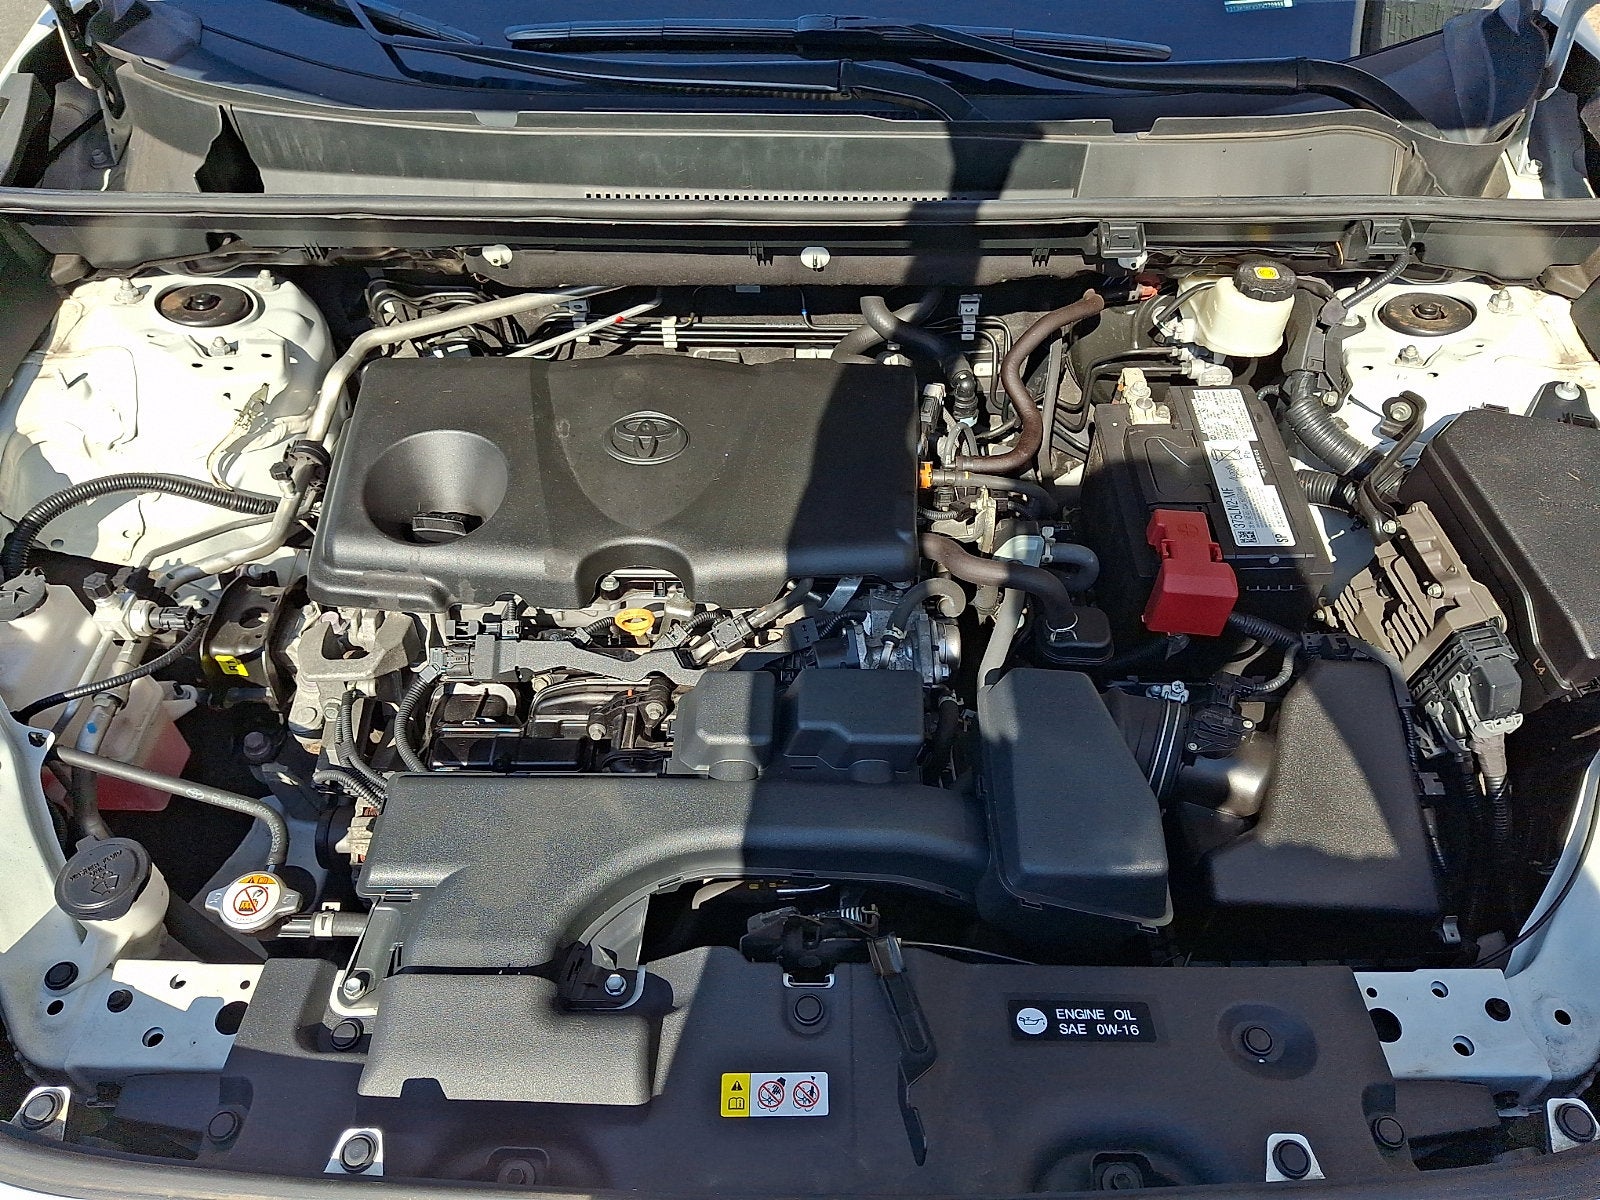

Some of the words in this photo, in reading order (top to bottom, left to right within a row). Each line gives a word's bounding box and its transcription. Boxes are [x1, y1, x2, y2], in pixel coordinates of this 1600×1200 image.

[1221, 487, 1246, 529] 375LN2-MF
[1055, 1008, 1106, 1020] ENGINE
[1113, 1009, 1137, 1021] OIL
[1059, 1023, 1088, 1035] SAE
[1096, 1024, 1140, 1036] 0W-16
